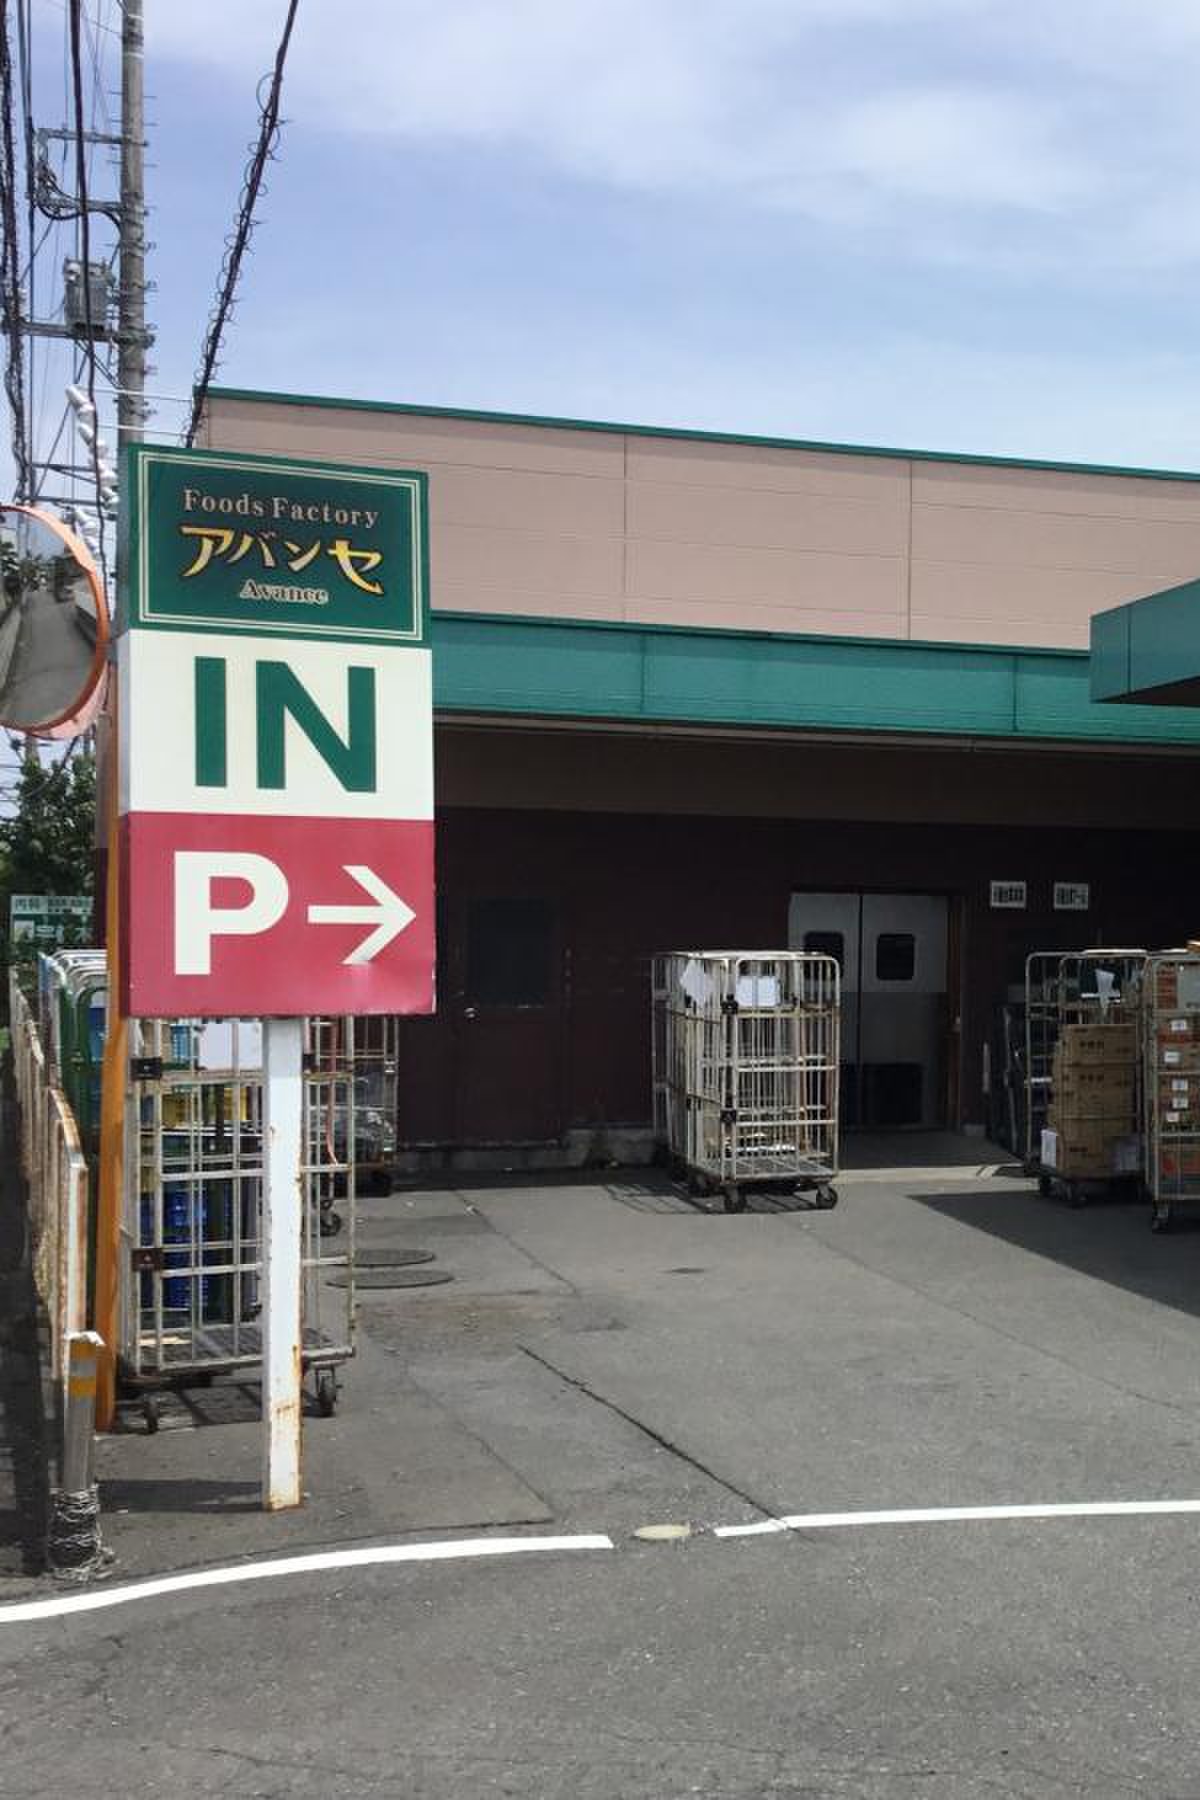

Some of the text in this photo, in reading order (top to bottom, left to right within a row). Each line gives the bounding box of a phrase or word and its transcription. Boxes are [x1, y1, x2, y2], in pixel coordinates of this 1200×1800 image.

[184, 488, 379, 528] Foods Factory
[180, 526, 385, 595] アバンセ
[240, 578, 329, 605] Avance
[194, 656, 377, 793] IN
[174, 850, 290, 975] P
